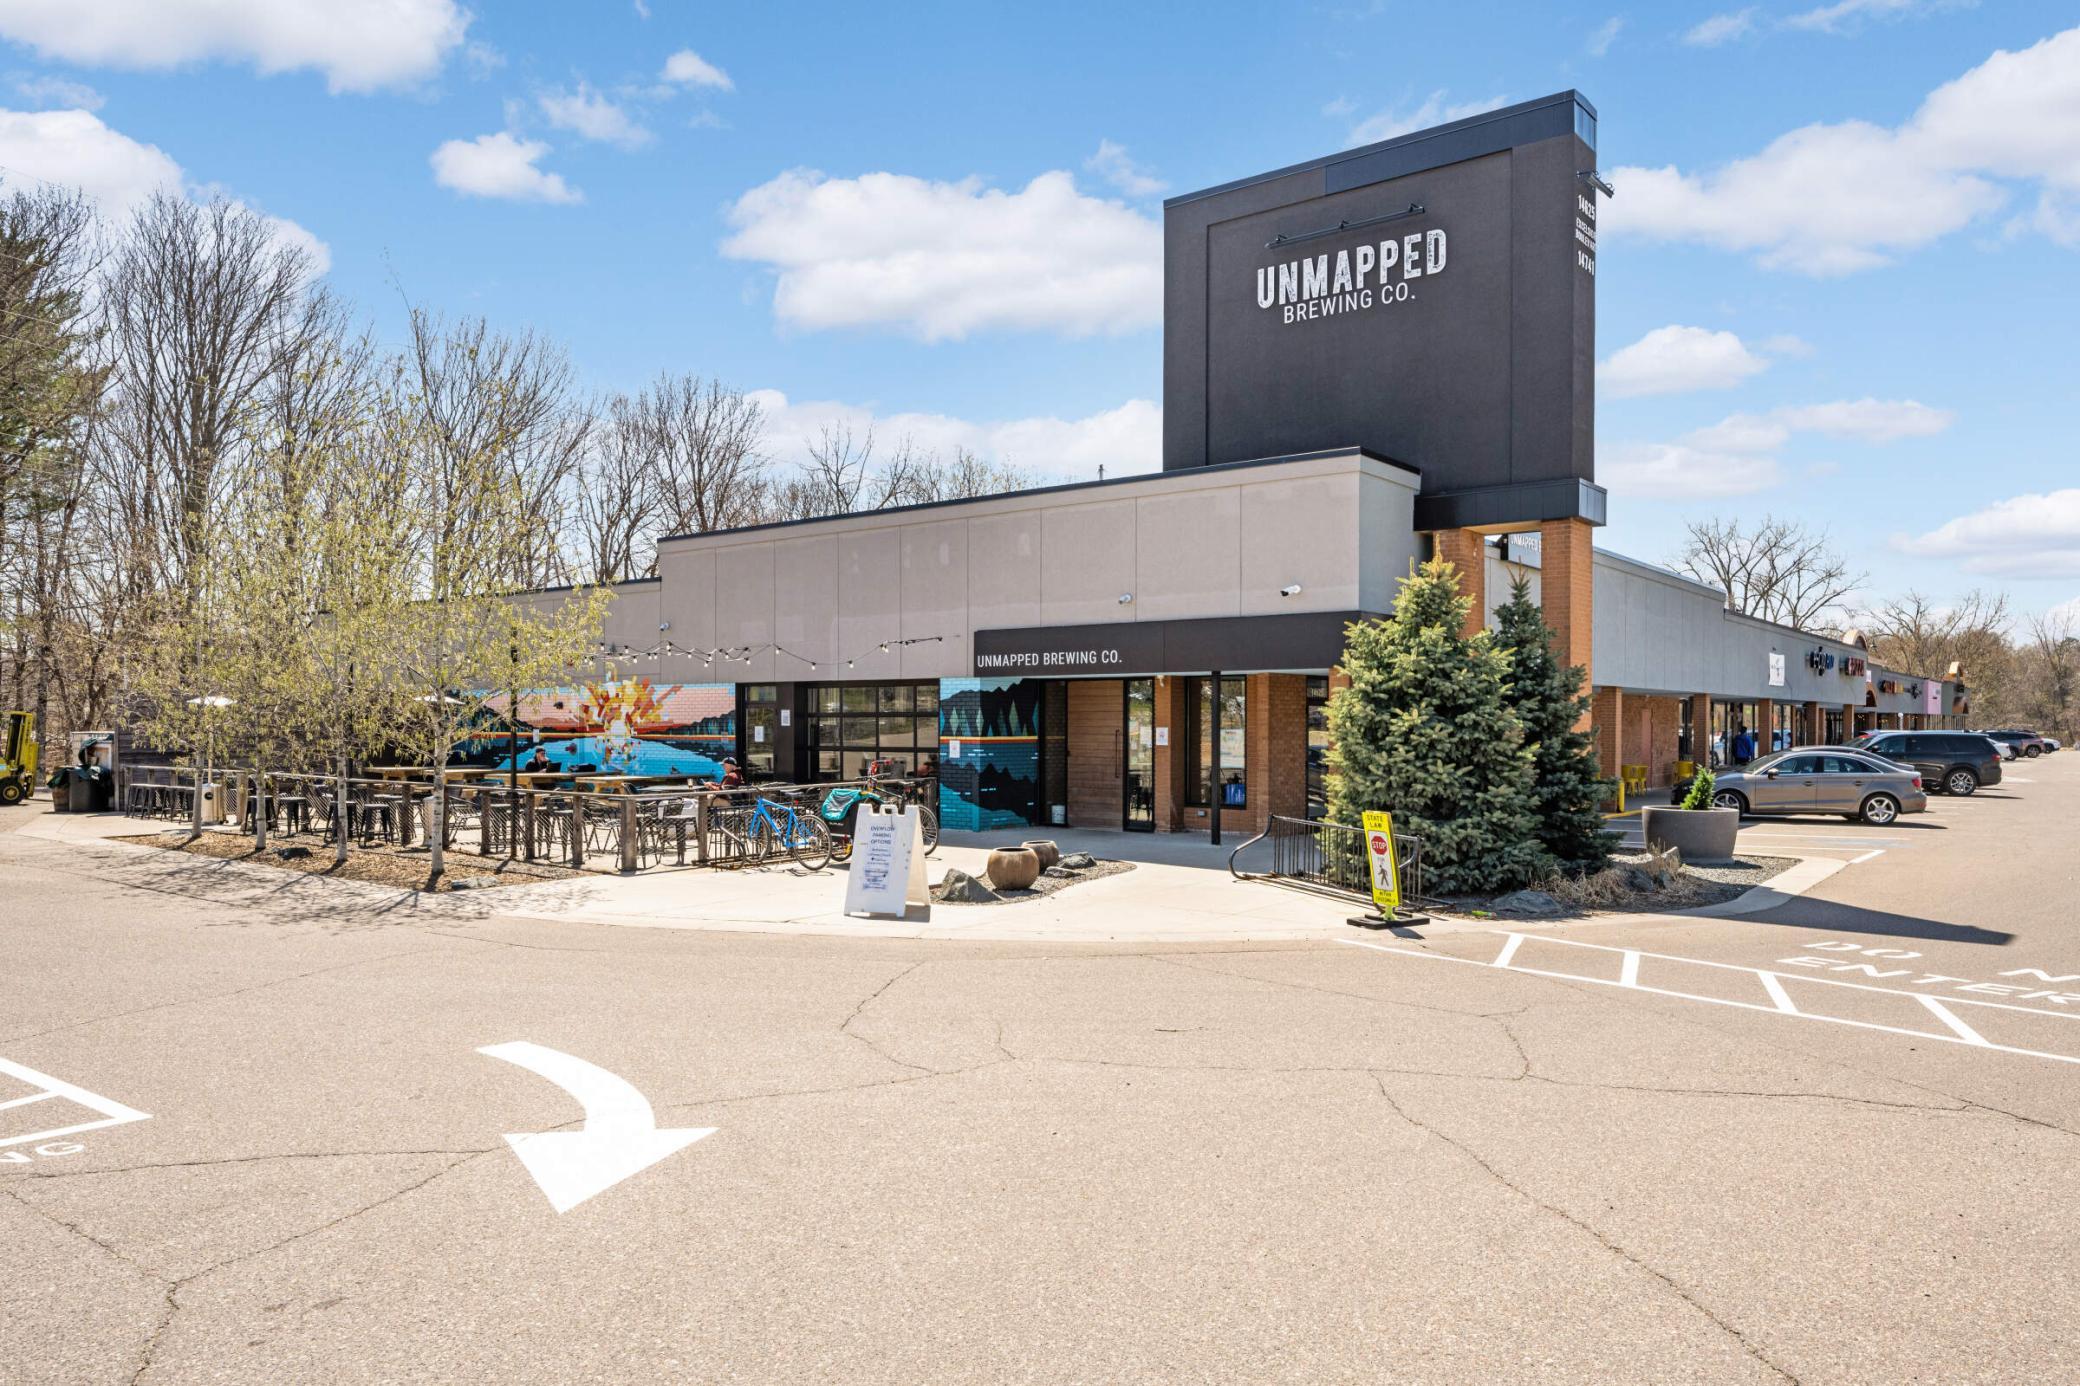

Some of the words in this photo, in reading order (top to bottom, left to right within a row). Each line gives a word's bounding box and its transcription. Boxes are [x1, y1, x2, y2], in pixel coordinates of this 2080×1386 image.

[1257, 228, 1447, 309] UNMAPPED
[1284, 289, 1372, 324] BREWING
[1381, 282, 1416, 305] CO.
[977, 653, 1039, 668] UNMAPPED
[1043, 651, 1097, 665] BREWING
[1101, 650, 1123, 664] CO.
[1371, 841, 1387, 849] STOP
[1803, 941, 1923, 959] DO
